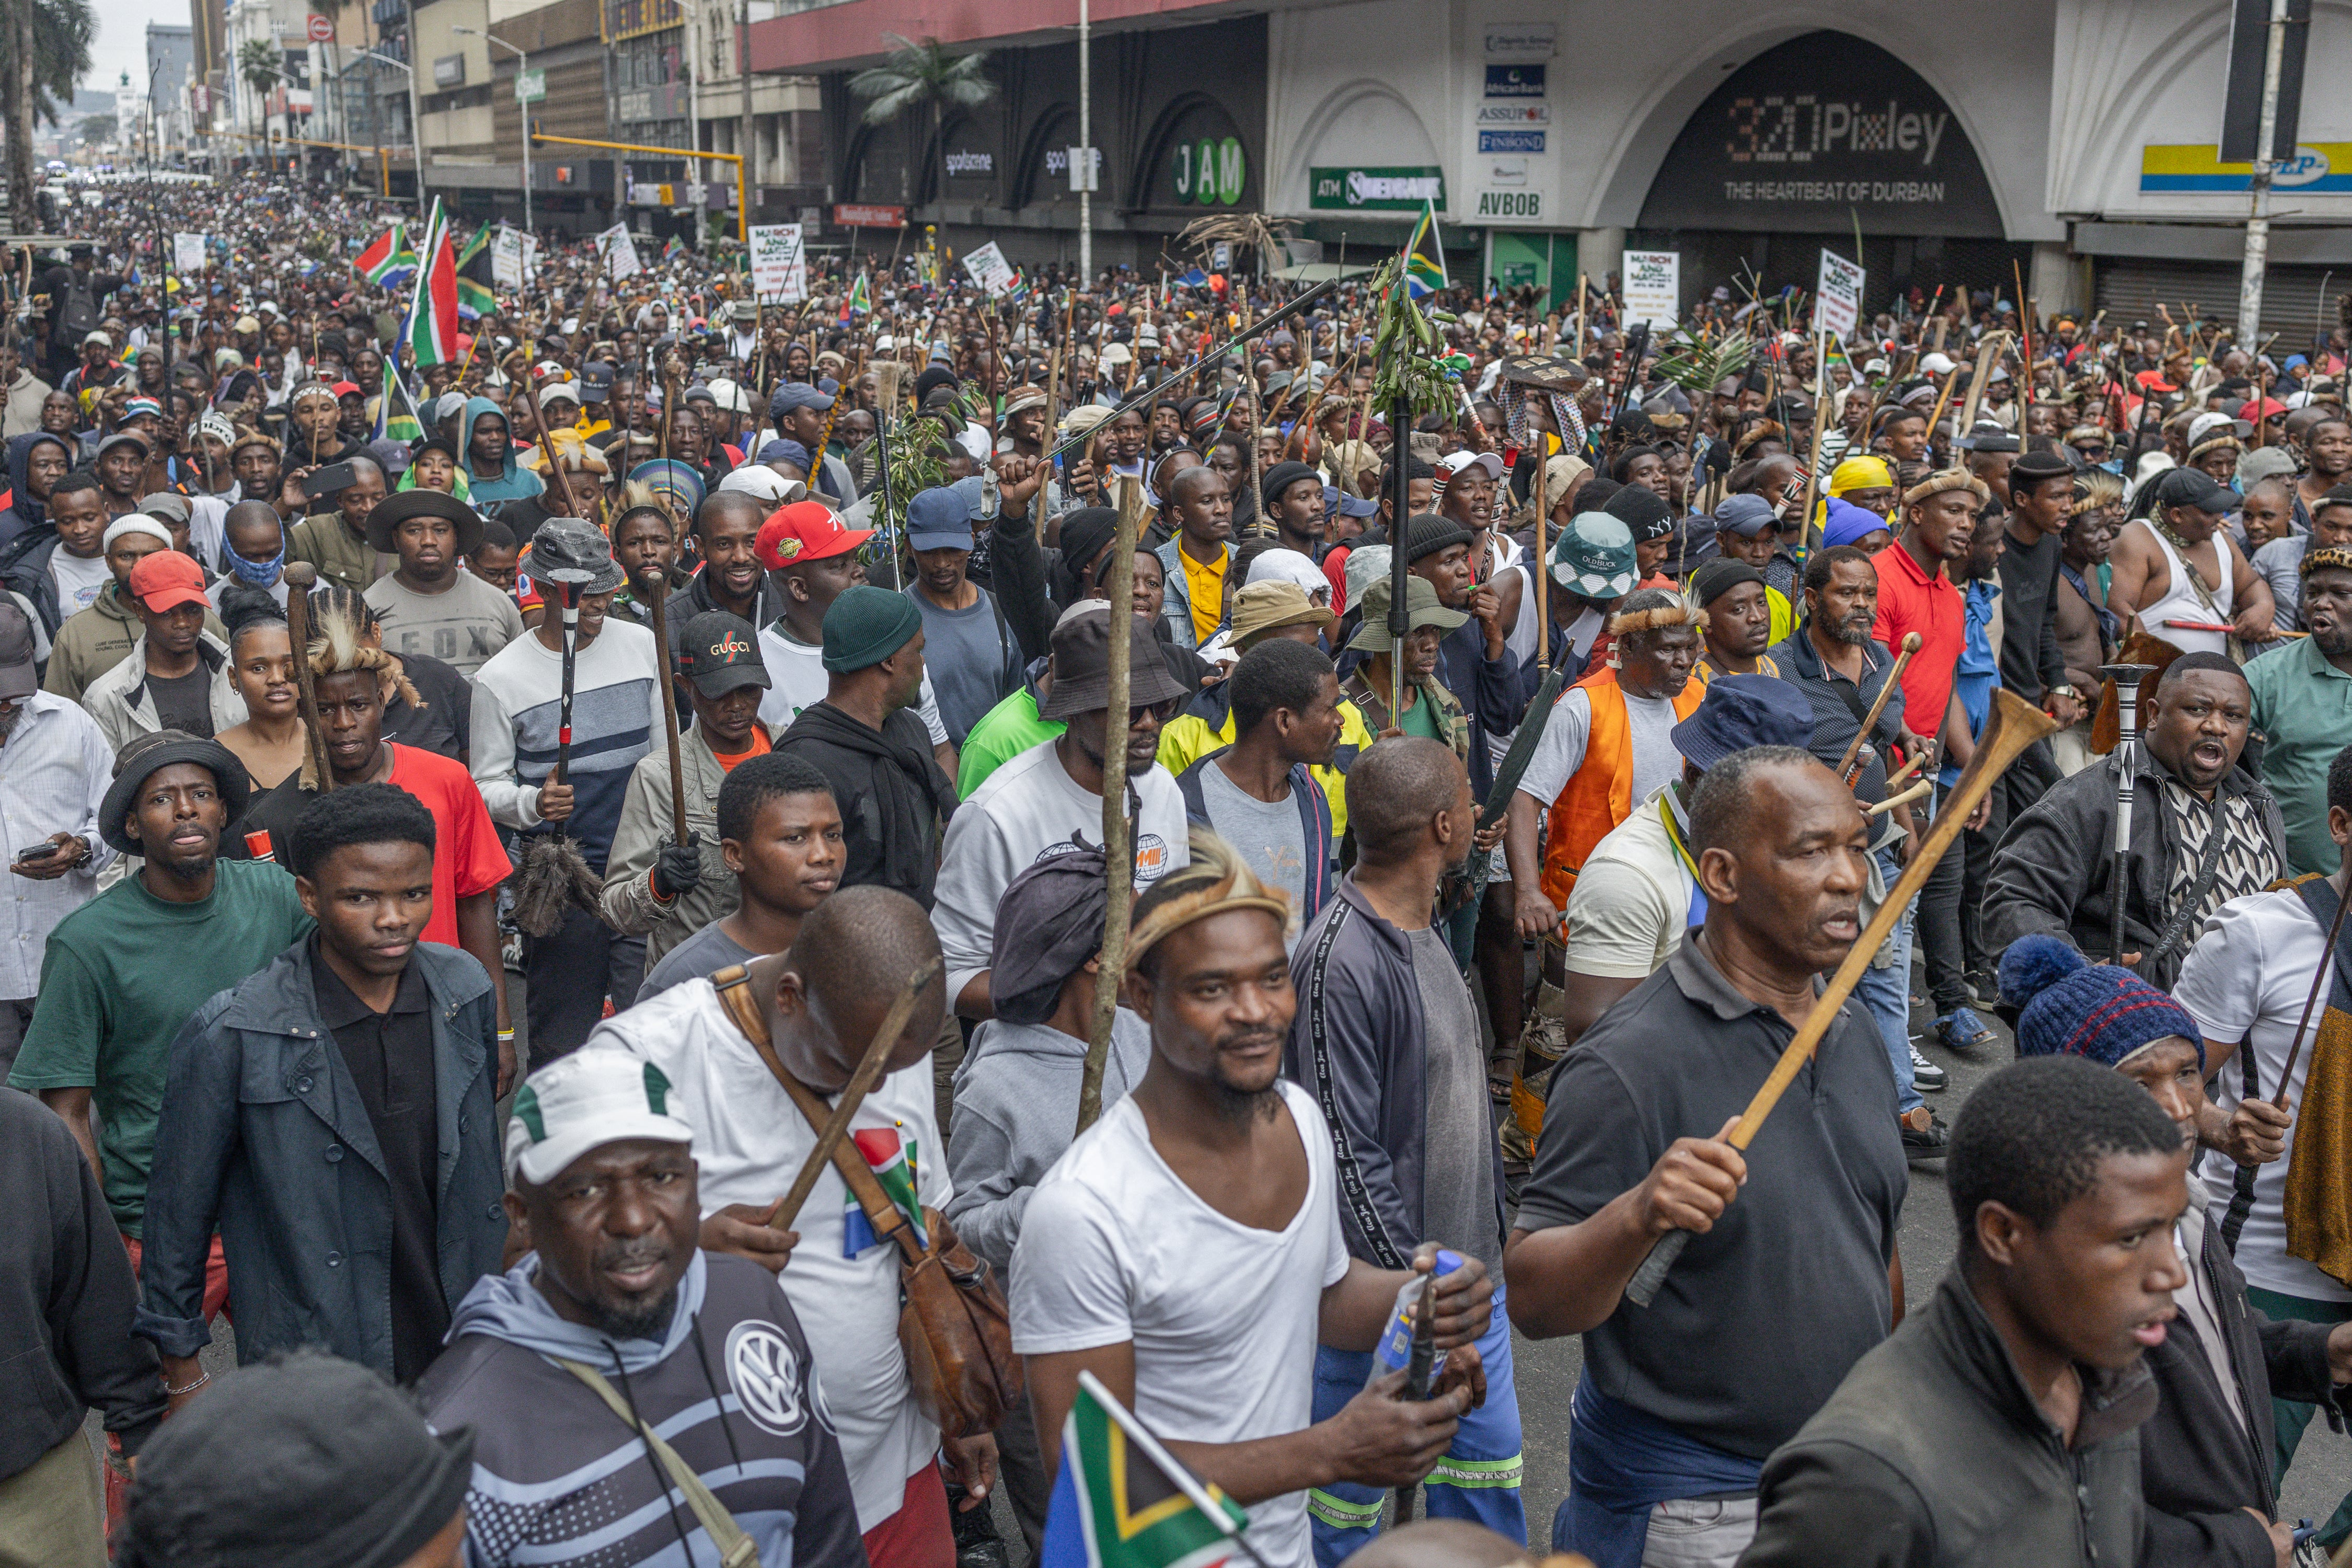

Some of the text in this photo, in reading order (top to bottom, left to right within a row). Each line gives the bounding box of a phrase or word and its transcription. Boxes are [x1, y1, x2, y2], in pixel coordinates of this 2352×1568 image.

[1478, 107, 1548, 121] ASSUPOL
[1177, 144, 1241, 194] JAM
[2270, 156, 2316, 176] EP
[1317, 179, 1341, 197] ATM
[1725, 181, 1945, 202] THE HEARTBEAT OF DURBAN
[1479, 192, 1540, 216] AVBOB
[756, 229, 795, 237] MARCH
[1631, 256, 1671, 264] MARCH
[1648, 516, 1671, 538] NY
[1582, 555, 1616, 568] OLD BUCK
[710, 641, 751, 656] GUCCI
[2199, 826, 2221, 885] OLD KHAKI
[2157, 897, 2197, 953] OLD KHAKI
